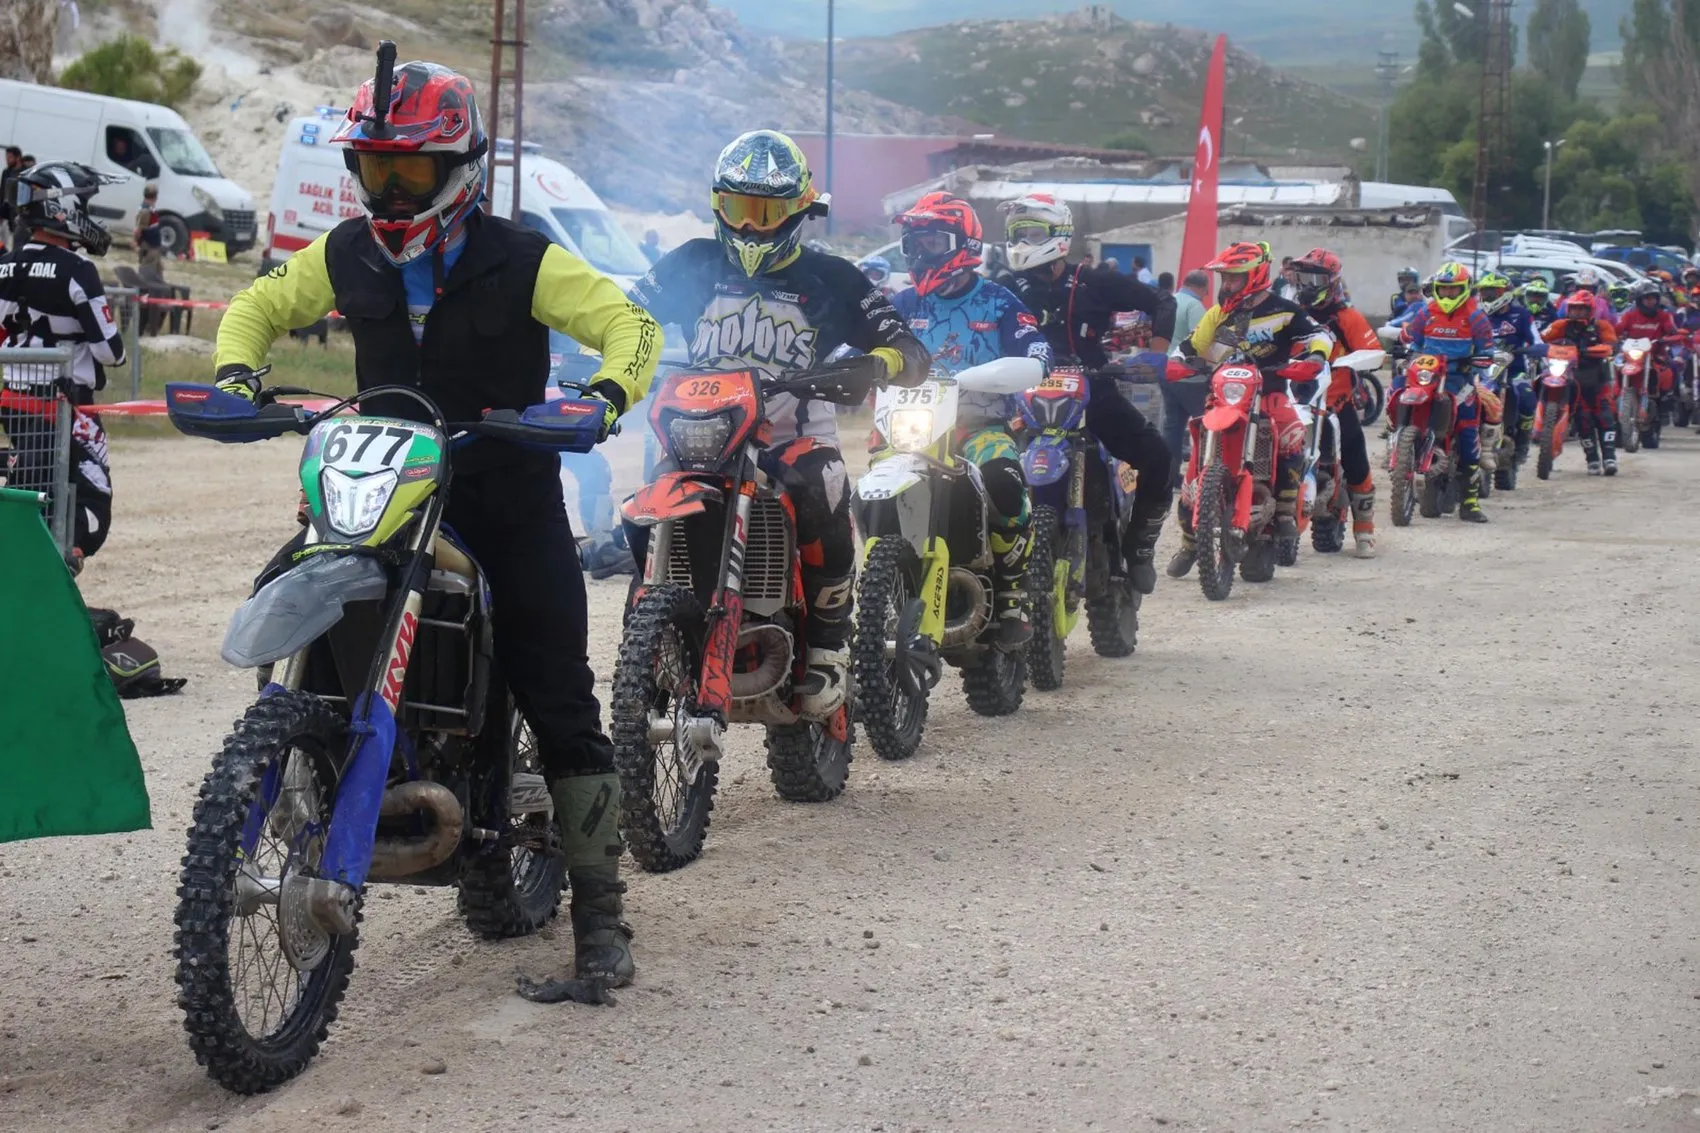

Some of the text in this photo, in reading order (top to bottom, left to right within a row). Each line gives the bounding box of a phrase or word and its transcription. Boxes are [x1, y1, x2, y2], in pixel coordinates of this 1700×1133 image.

[21, 262, 57, 279] ZDAL
[1416, 357, 1435, 366] 44
[688, 381, 721, 396] 326
[897, 389, 933, 405] 375
[322, 424, 414, 467] 677
[291, 544, 351, 561] SHERCO
[932, 566, 945, 620] ACERBIS
